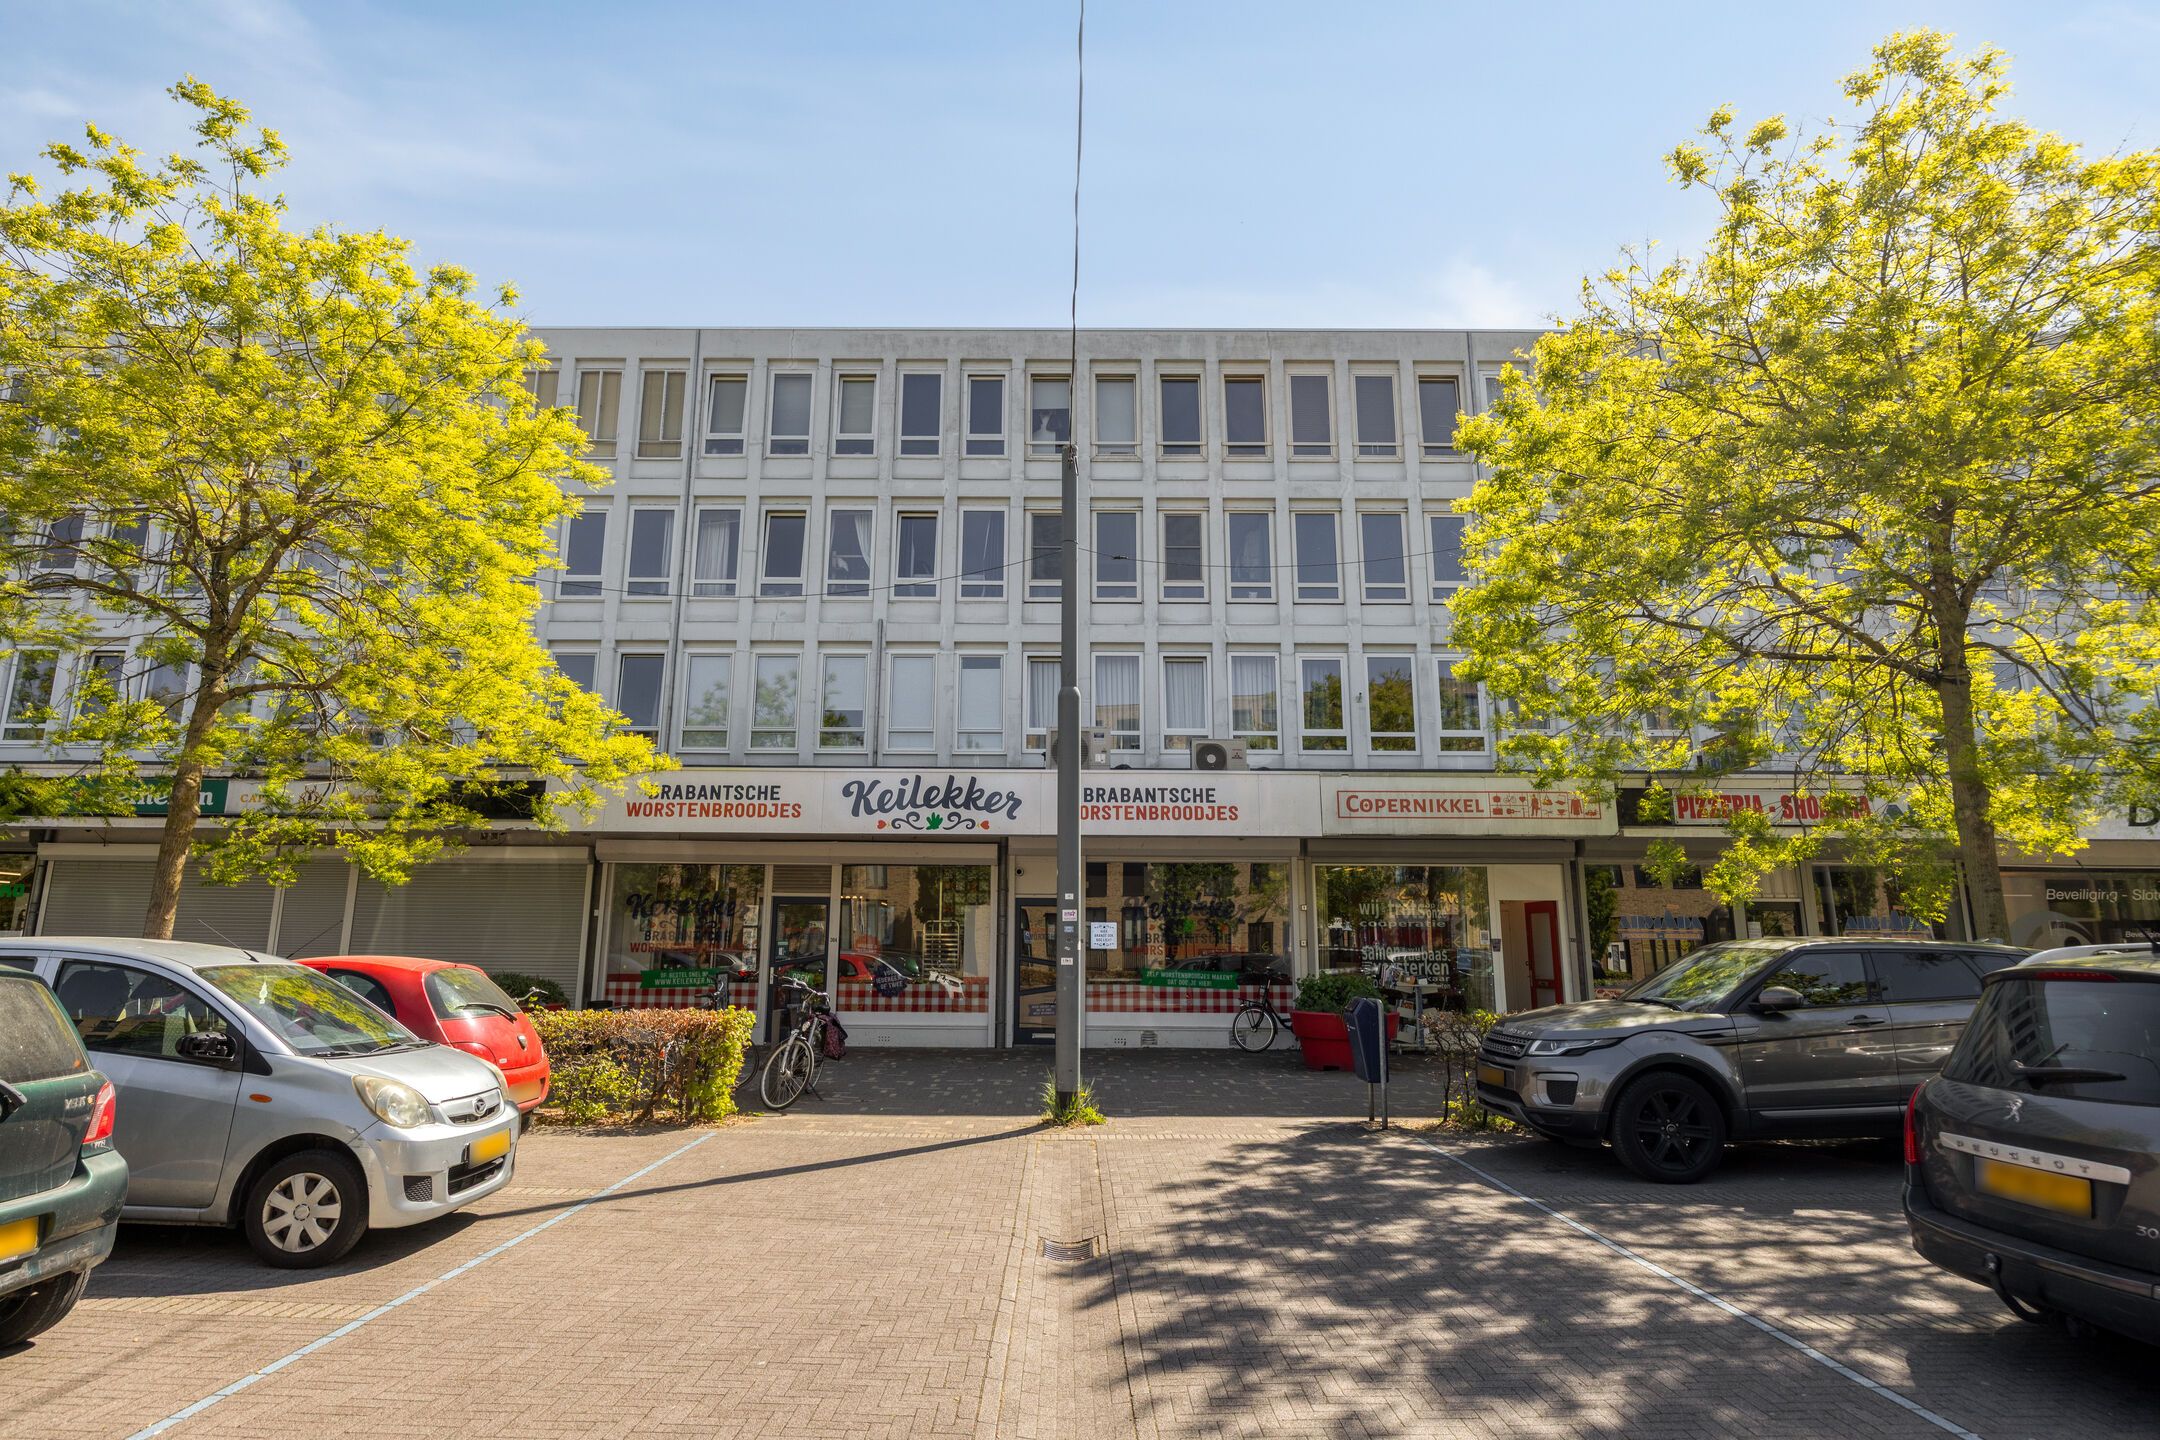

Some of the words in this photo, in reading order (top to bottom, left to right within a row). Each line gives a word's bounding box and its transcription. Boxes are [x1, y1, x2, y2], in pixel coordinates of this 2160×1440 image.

[648, 784, 781, 800] RABANTSCHE
[842, 774, 1022, 820] Keilekker
[1083, 787, 1216, 803] BRABANTSCHE
[626, 802, 802, 818] WORSTENBROODJES
[1346, 795, 1485, 813] COPERNIKKEL
[1080, 805, 1239, 821] ORSTENBROODJES
[2046, 888, 2118, 902] Beveiliging
